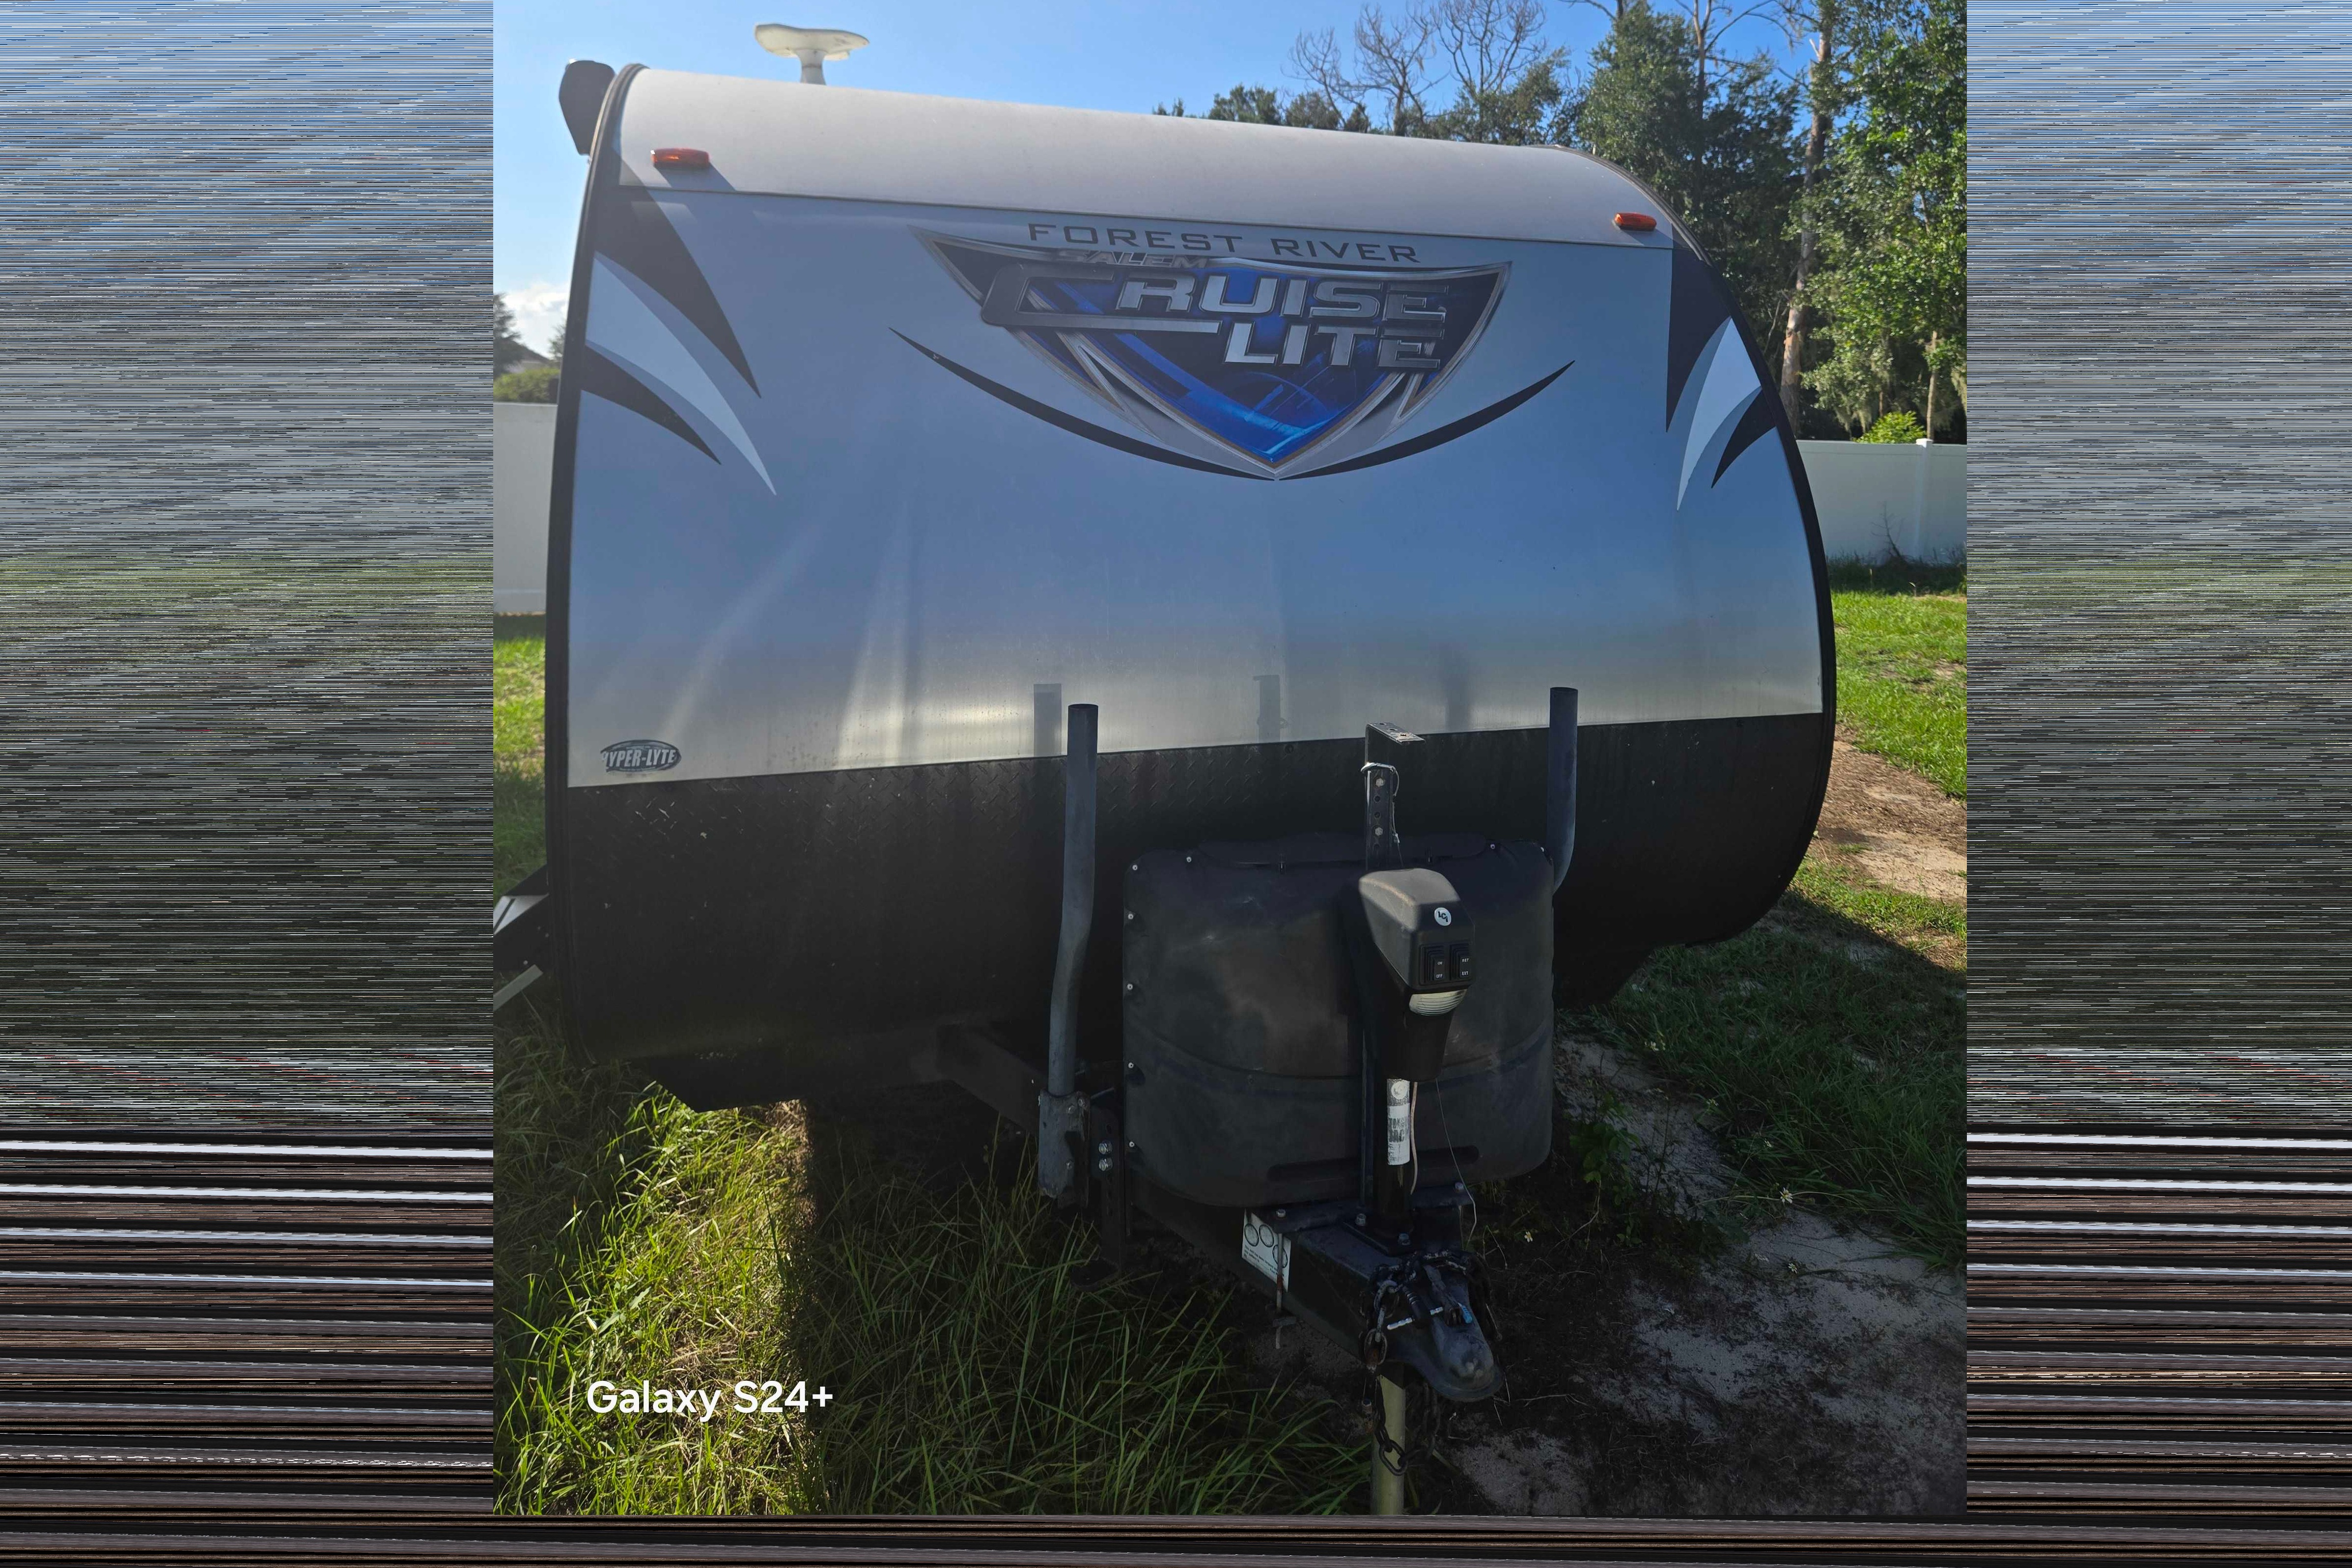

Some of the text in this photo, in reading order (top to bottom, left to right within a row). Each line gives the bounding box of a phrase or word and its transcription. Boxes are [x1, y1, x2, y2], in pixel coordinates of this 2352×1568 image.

[1028, 223, 1421, 263] FOREST RIVER
[1058, 249, 1209, 269] SALEM
[981, 263, 1449, 335] CRUISE
[1223, 321, 1445, 368] LITE
